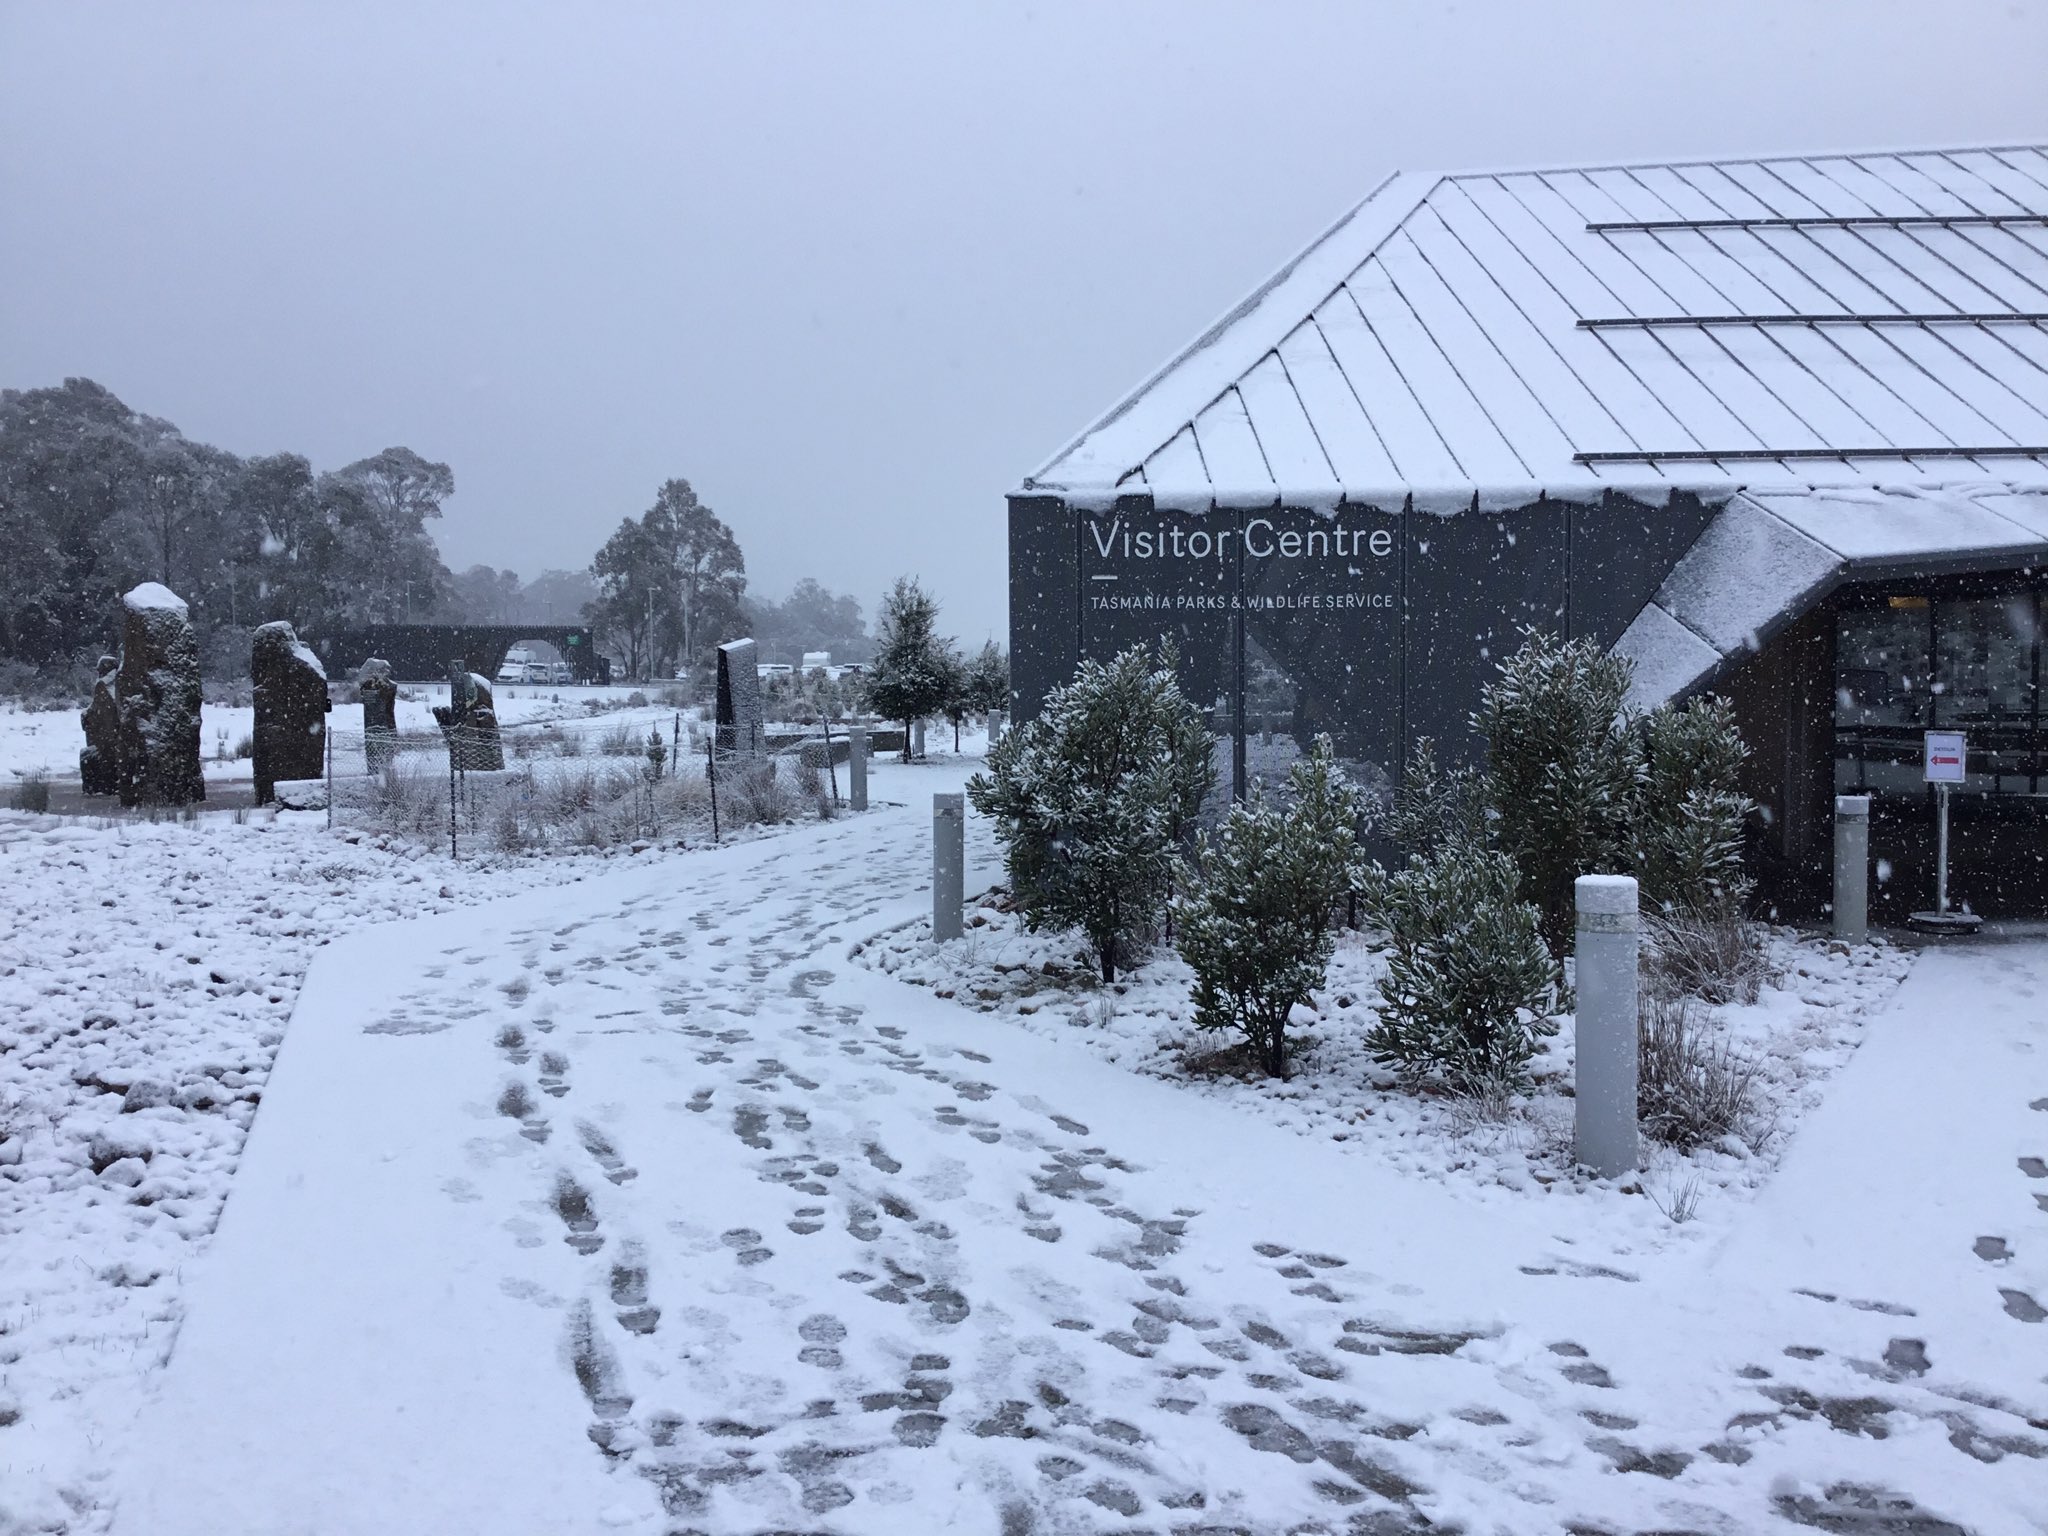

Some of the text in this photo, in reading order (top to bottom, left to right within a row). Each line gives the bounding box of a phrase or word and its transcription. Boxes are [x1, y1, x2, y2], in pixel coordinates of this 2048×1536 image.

[1089, 518, 1393, 558] Visitor Centre
[1090, 595, 1393, 609] TASMANIA PARKS & WILDLIFE SERVICE
